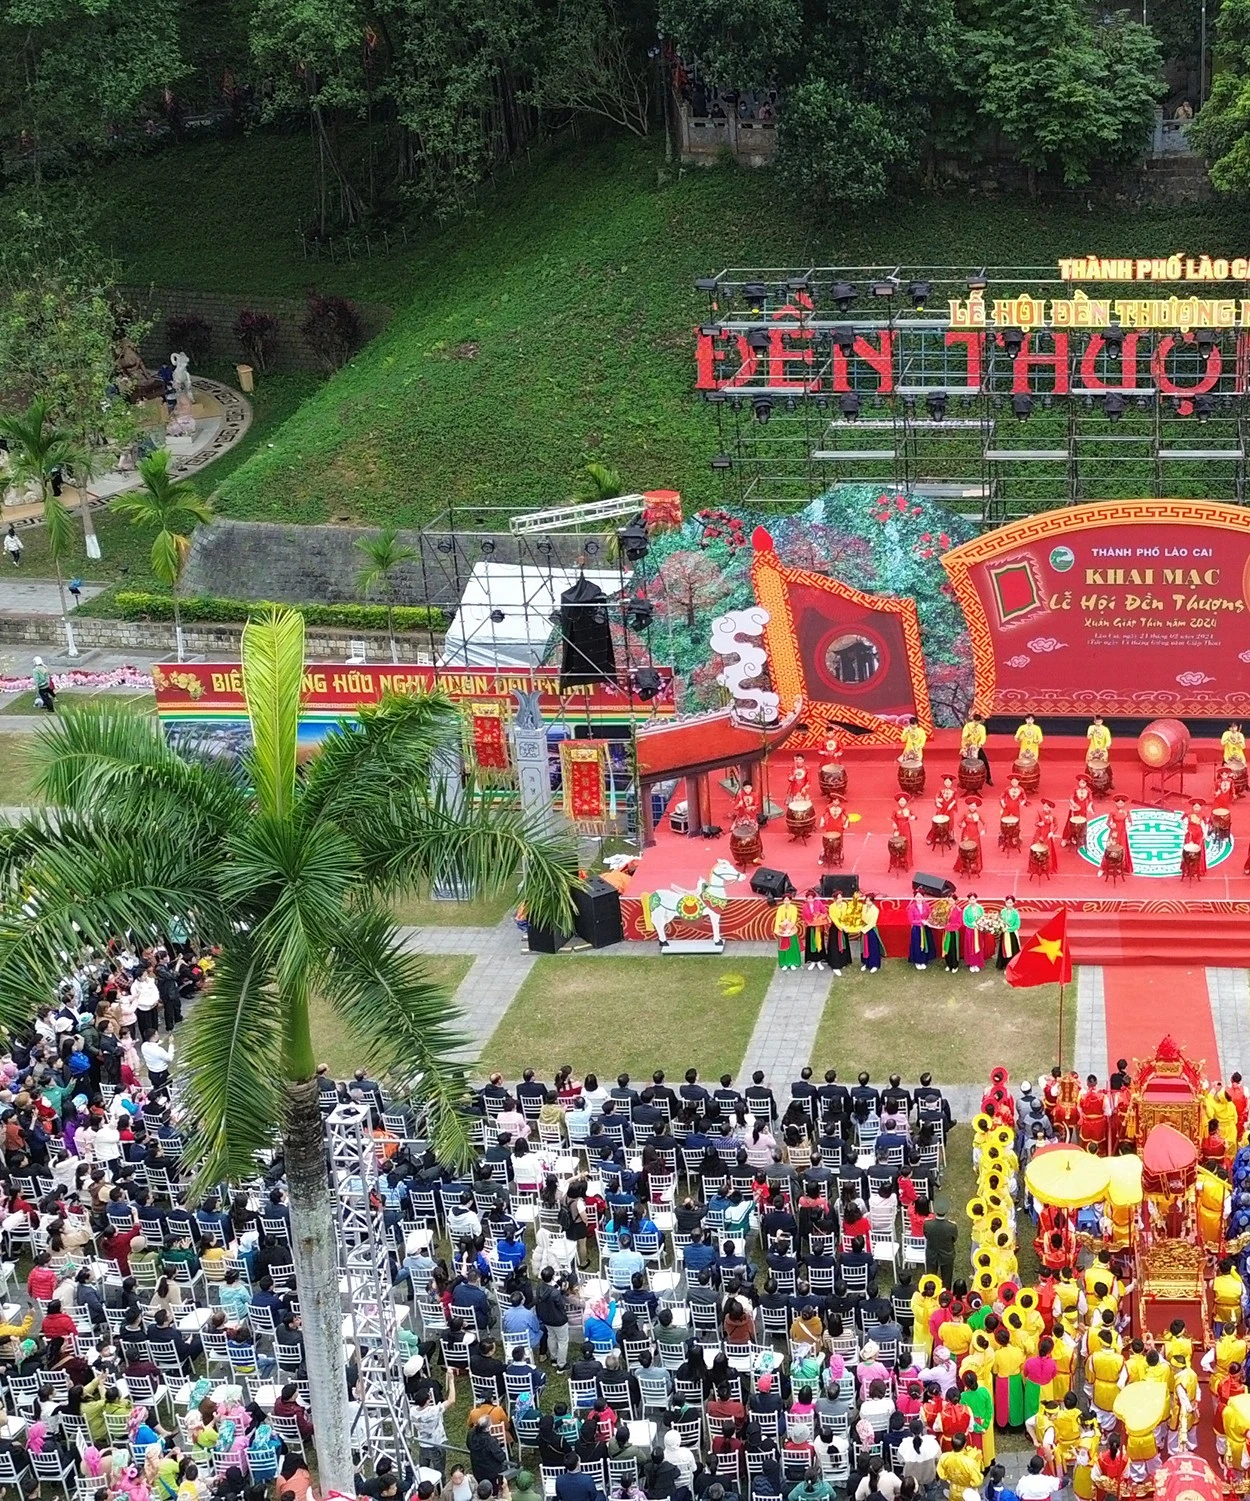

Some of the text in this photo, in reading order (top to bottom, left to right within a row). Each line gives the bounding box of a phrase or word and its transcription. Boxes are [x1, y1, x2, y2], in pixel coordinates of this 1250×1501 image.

[1059, 255, 1133, 280] THÀNH
[1136, 252, 1185, 280] PHỐ
[1186, 255, 1230, 280] LÀO
[948, 289, 986, 327] LỄ
[991, 293, 1046, 332] HỘI
[1051, 289, 1112, 327] ĐỀN
[1114, 296, 1236, 333] THƯỢNG
[694, 291, 900, 393] ĐỀN
[1091, 545, 1213, 557] THÀNH PHỐ LÀO CAI
[1084, 568, 1220, 589] KHAI MẠC
[1049, 591, 1245, 615] Lễ Hội Đền Thượng
[211, 669, 243, 693] BIÊ
[333, 670, 374, 694] HỮU
